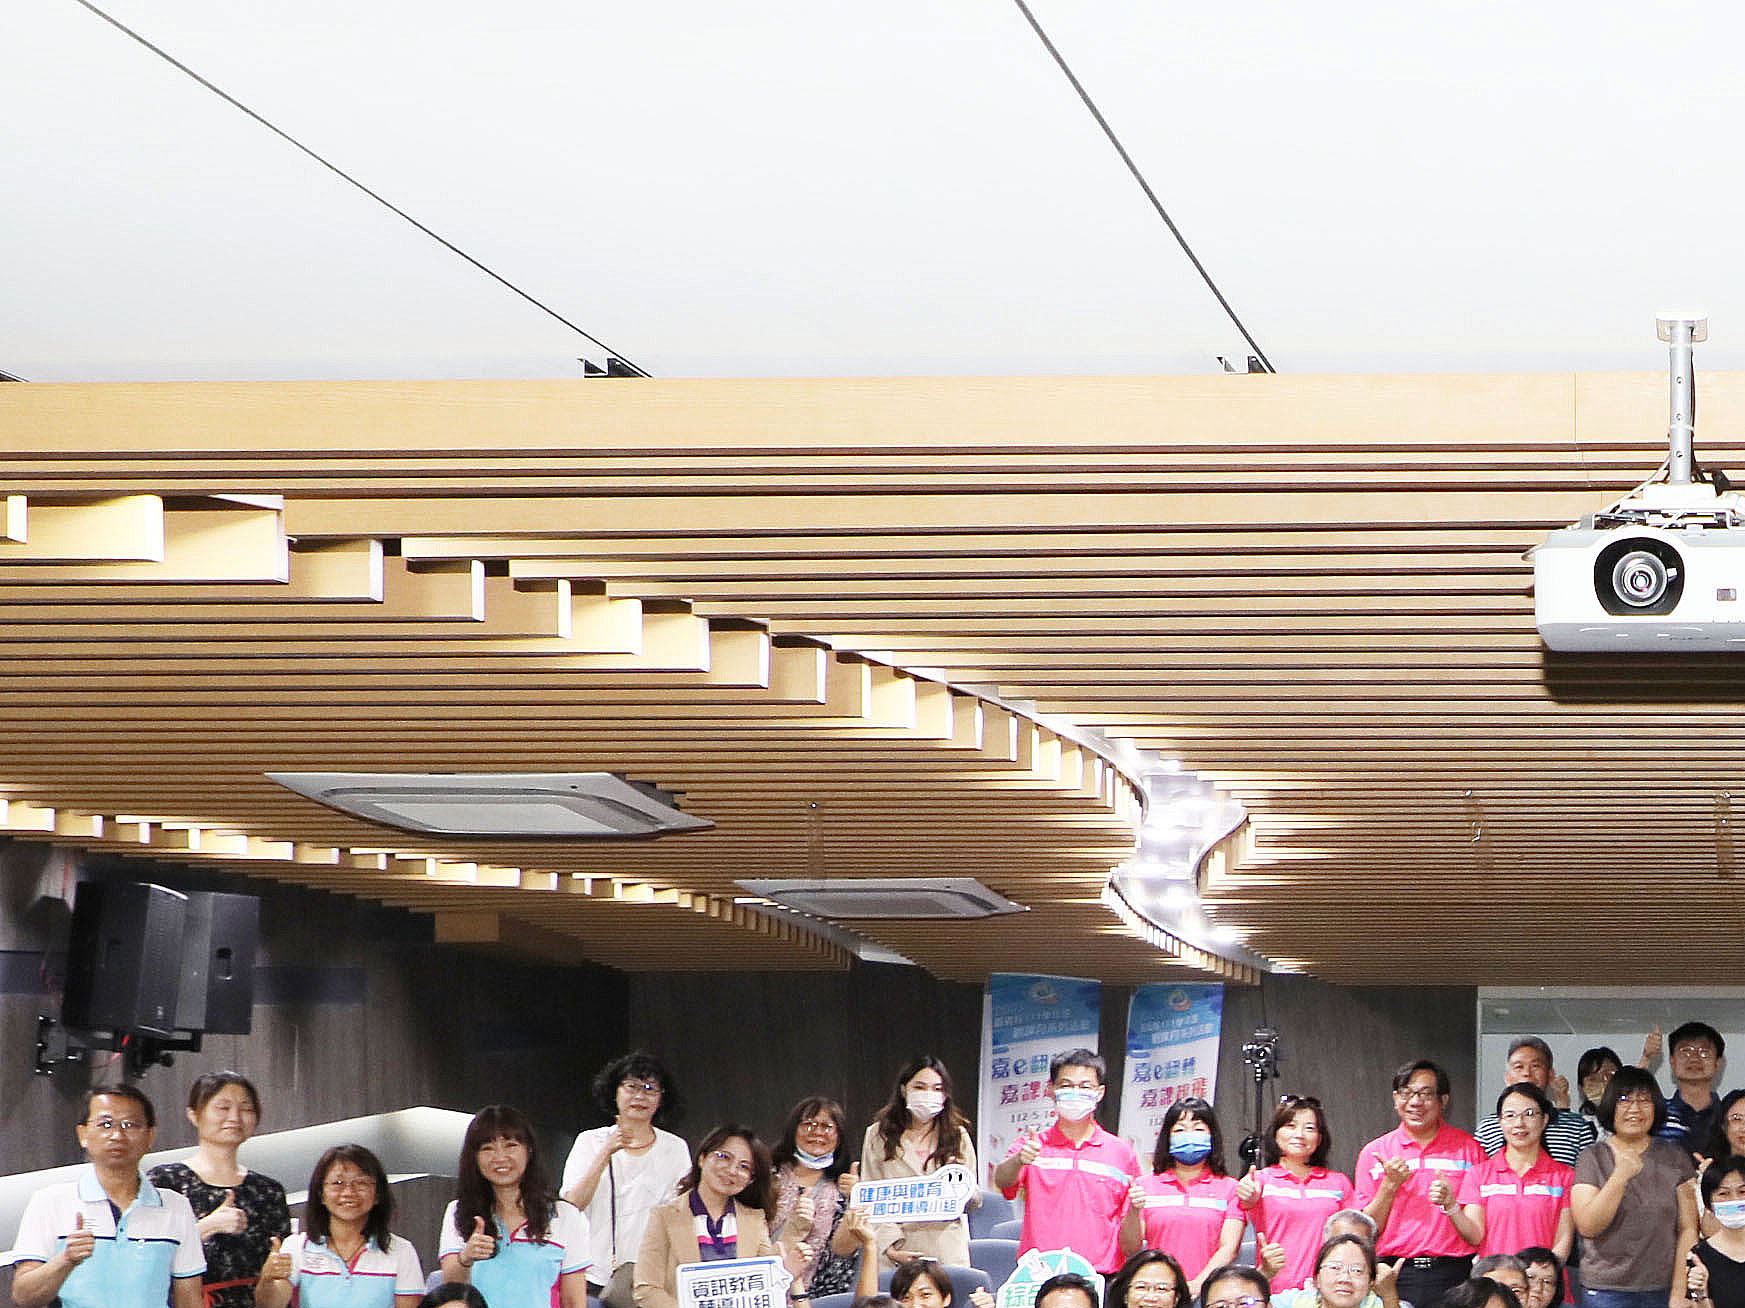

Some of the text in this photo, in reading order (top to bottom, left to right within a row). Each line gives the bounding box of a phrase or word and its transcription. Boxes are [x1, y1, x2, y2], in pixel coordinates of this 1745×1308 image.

[992, 1055, 1058, 1079] 嘉e翻
[860, 1181, 942, 1203] 健康與體育
[873, 1199, 957, 1216] 國中輔導小組
[691, 1273, 765, 1299] 資訊教育
